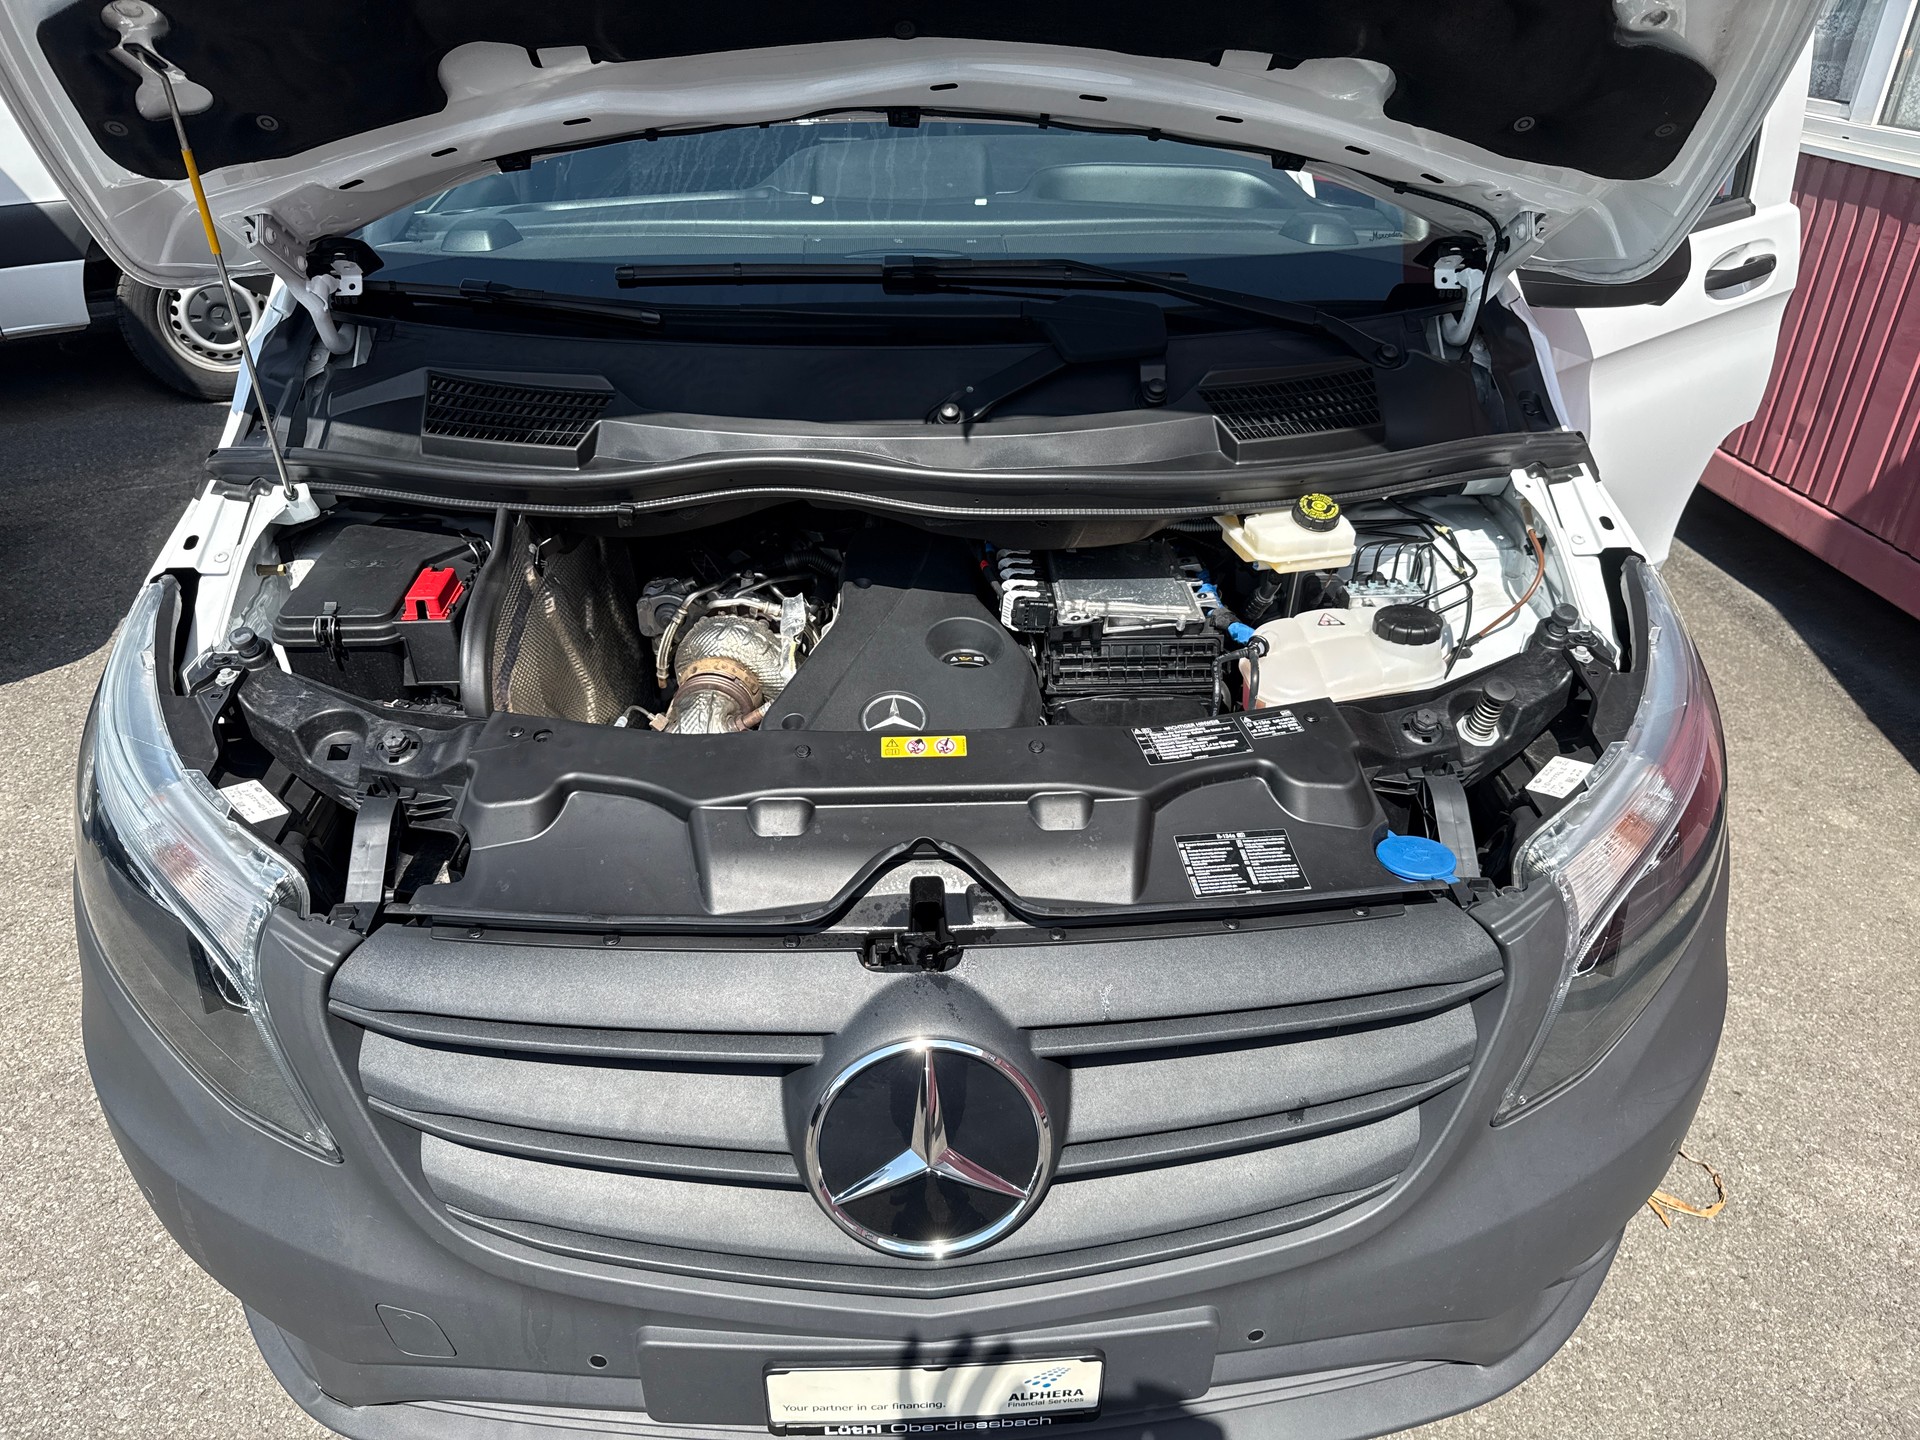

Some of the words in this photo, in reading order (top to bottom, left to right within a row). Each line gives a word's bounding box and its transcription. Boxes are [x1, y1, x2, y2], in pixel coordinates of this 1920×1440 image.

[1009, 1388, 1084, 1401] ALPHERA
[783, 1404, 808, 1412] Your
[812, 1403, 853, 1413] partner
[857, 1403, 867, 1411] in
[892, 1400, 947, 1410] financing.
[1007, 1399, 1046, 1408] Financial
[1048, 1397, 1085, 1405] Services
[890, 1416, 1052, 1433] Oberdiessbach
